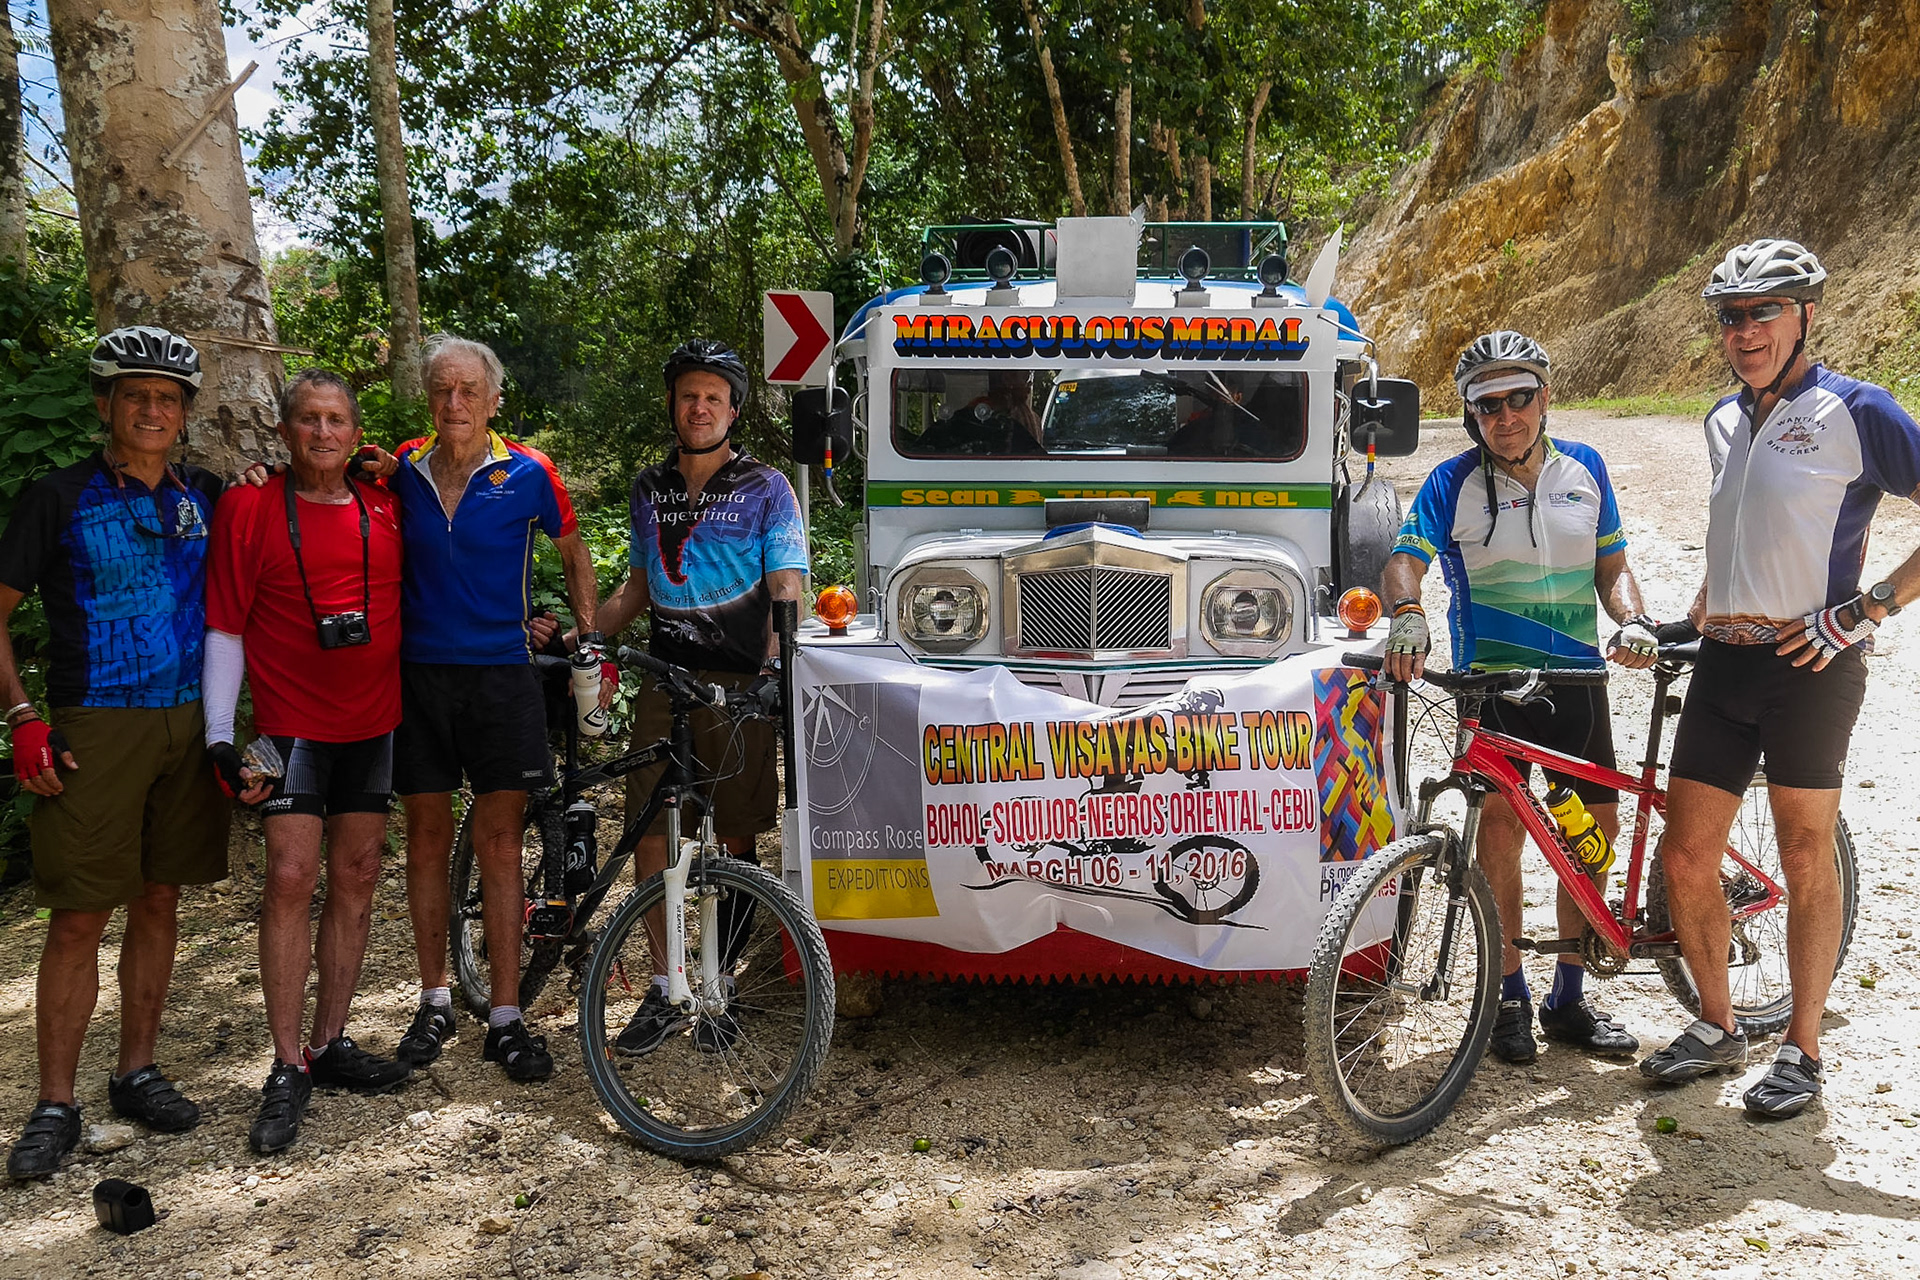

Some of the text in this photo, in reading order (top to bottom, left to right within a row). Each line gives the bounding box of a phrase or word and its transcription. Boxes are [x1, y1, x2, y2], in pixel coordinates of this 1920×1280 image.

[892, 315, 1310, 361] MIRACULOUS MEDAL
[1766, 439, 1820, 455] BIKE CREW
[1548, 492, 1567, 501] EDF
[82, 517, 164, 561] HASH
[92, 558, 172, 594] HOUSE
[923, 709, 1313, 786] CENTRAL VISAYAS BIKE TOUR
[811, 824, 923, 857] Compass Rose
[1517, 781, 1585, 876] MARIN
[827, 867, 930, 891] EXPEDITIONS
[985, 857, 1083, 886] MARCH
[1091, 856, 1121, 885] 06
[1146, 852, 1182, 884] 11,
[1188, 851, 1248, 880] 2016
